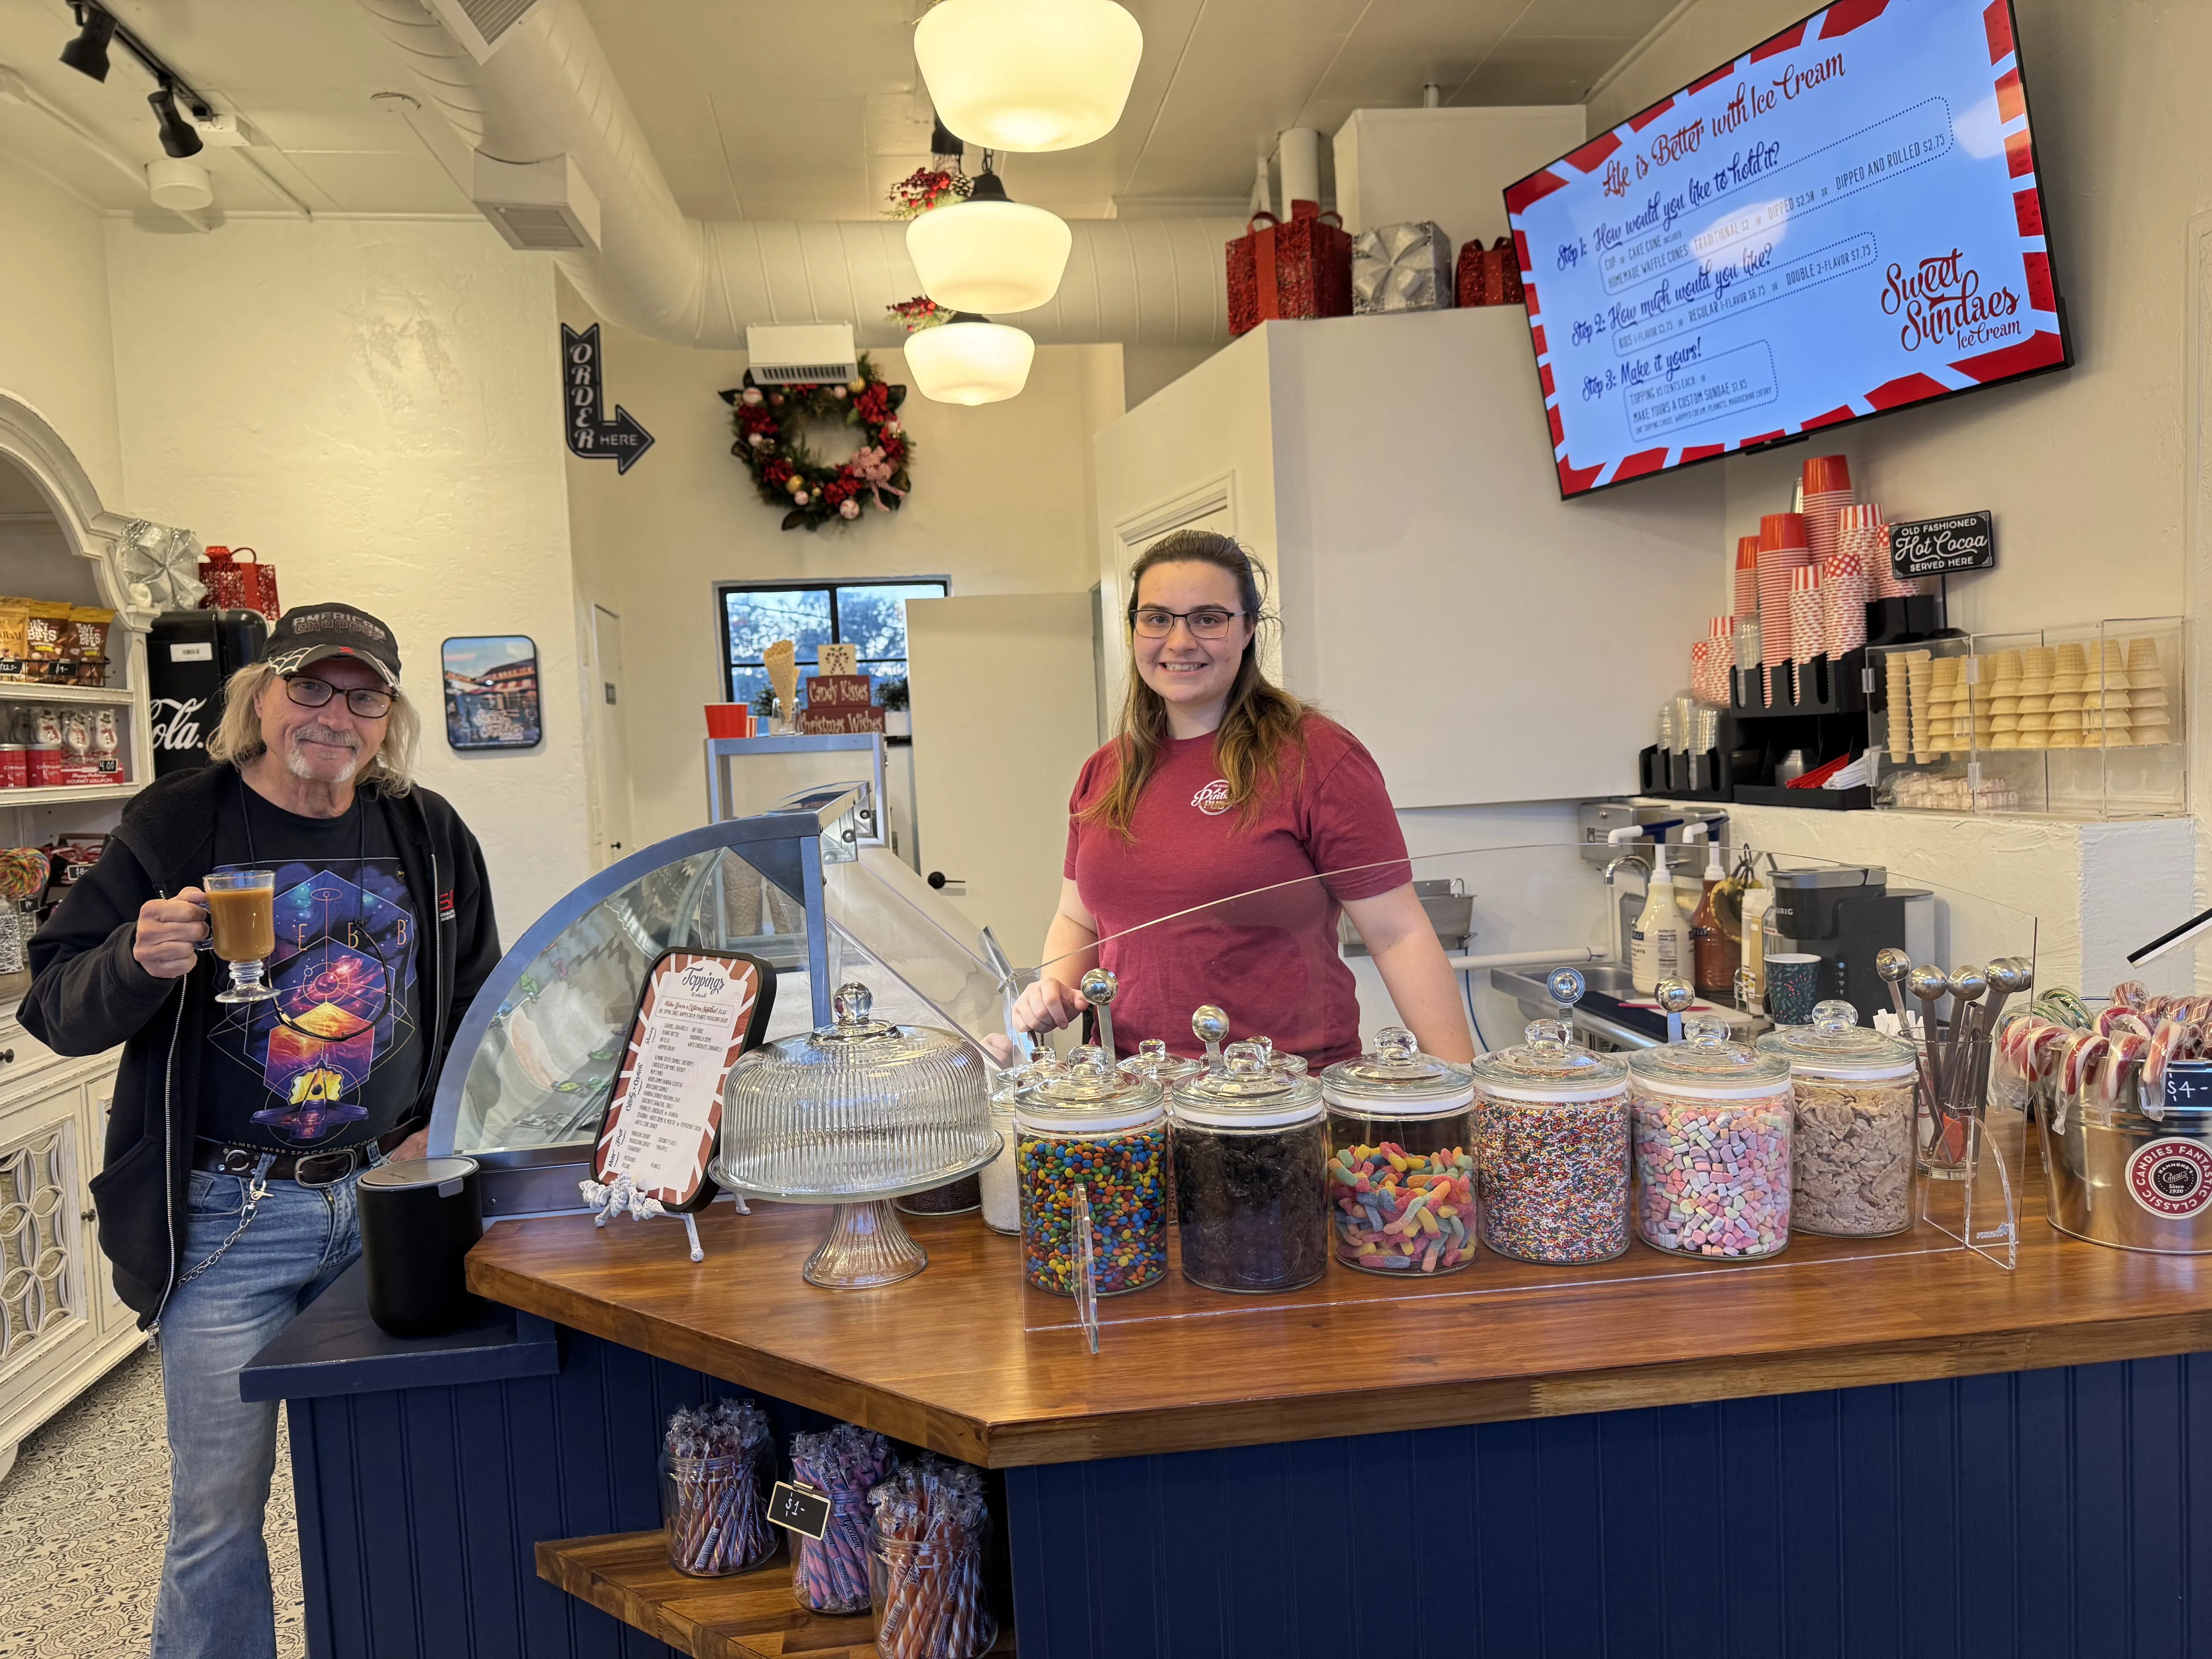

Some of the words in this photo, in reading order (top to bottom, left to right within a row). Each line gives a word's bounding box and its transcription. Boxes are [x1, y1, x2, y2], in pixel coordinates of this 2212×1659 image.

[1602, 159, 1631, 197] Life
[1636, 154, 1649, 180] is
[1651, 117, 1705, 166] Better
[1712, 82, 1749, 137] with
[1751, 85, 1777, 118] Ice
[1772, 52, 1846, 100] Cream
[1557, 244, 1578, 271] Step
[1578, 237, 1587, 256] 1:
[1593, 223, 1623, 251] How
[1625, 191, 1661, 234] would
[1663, 194, 1685, 232] you
[1689, 177, 1711, 206] like
[1713, 168, 1729, 192] to
[1727, 141, 1764, 183] hold
[1764, 141, 1780, 169] it?
[1640, 252, 1666, 273] WAFFLE
[1694, 224, 1740, 251] TRADITIONAL
[1741, 219, 1750, 232] $2
[1767, 197, 1794, 220] DIPPED
[1796, 191, 1815, 208] $2.50
[1836, 166, 1865, 191] DIPPED
[1868, 157, 1885, 177] AND
[1887, 142, 1921, 169] ROLLED
[1923, 134, 1946, 152] $2.75
[1628, 245, 1645, 260] CAKE
[1645, 235, 1662, 253] CONE
[1571, 320, 1593, 347] Step
[1594, 313, 1606, 334] 2:
[1608, 302, 1638, 329] How
[1640, 278, 1670, 318] much
[1675, 259, 1712, 302] would
[1714, 263, 1739, 300] you
[1742, 242, 1772, 277] like?
[1688, 301, 1719, 323] REGULAR
[1786, 263, 1815, 286] DOUBLE
[1816, 252, 1850, 275] 2-FLAVOR
[1851, 244, 1871, 261] $7.75
[1881, 248, 1963, 315] Sweet
[1901, 270, 2020, 351] Sundaes
[1957, 330, 1975, 350] Ice
[1970, 320, 2021, 343] Cream
[1582, 375, 1604, 402] Step
[1605, 369, 1616, 391] 3:
[1620, 359, 1650, 386] Make
[1654, 354, 1663, 373] it
[1665, 336, 1702, 381] yours!
[569, 343, 595, 449] ORDER
[1630, 387, 1656, 405] TOPPING
[1633, 408, 1650, 423] MAKE
[1651, 402, 1671, 417] YOURS
[1672, 399, 1677, 411] A
[1678, 391, 1704, 409] CUSTOM
[1704, 382, 1730, 401] SUNDAE
[599, 434, 639, 446] HERE
[1901, 527, 1920, 536] OLD
[1923, 518, 1977, 533] FASHIONED
[1895, 535, 1940, 562] Hot
[1934, 531, 1988, 557] Cocoa
[1910, 560, 1944, 572] SERVED
[1948, 556, 1973, 567] HERE
[809, 678, 838, 705] Candy
[840, 679, 868, 701] Kisses
[797, 712, 845, 735] Christmas
[847, 710, 882, 733] Wishes
[682, 967, 725, 994] Toppings
[645, 1026, 654, 1045] Sauce
[625, 1091, 637, 1111] Candy
[2137, 1146, 2173, 1186] CANDIES
[2158, 1163, 2193, 1174] HAMMOND'S
[2179, 1146, 2212, 1198] FANTASTIC
[2142, 1189, 2197, 1211] CLASSIC
[822, 1473, 833, 1491] COTTON
[925, 1518, 941, 1542] TANGERIN
